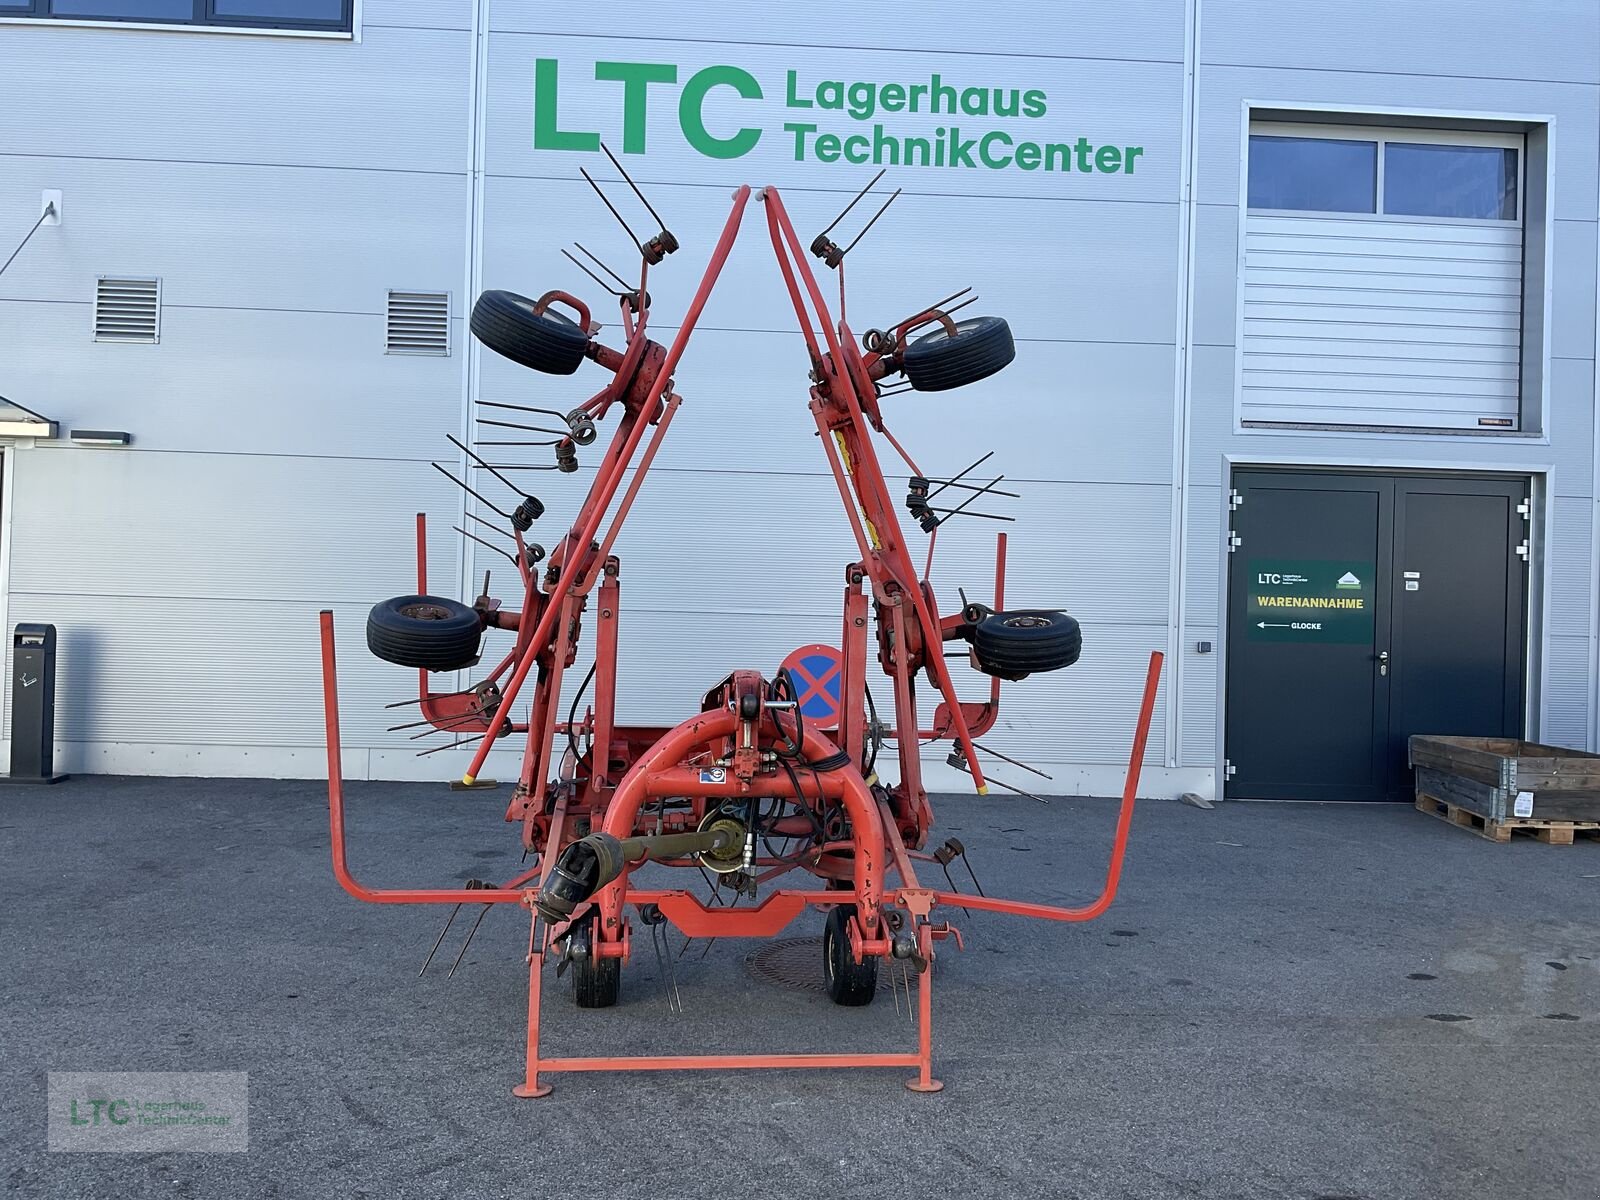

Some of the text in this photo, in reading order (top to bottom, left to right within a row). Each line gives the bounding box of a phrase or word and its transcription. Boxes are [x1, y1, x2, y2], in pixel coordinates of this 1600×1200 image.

[534, 58, 763, 159] LTC
[786, 70, 1047, 121] Lagerhaus
[784, 122, 1143, 175] TechnikCenter
[1258, 573, 1281, 585] LTC
[1257, 596, 1364, 609] WARENANNAHME
[1290, 622, 1322, 630] GLOCKE
